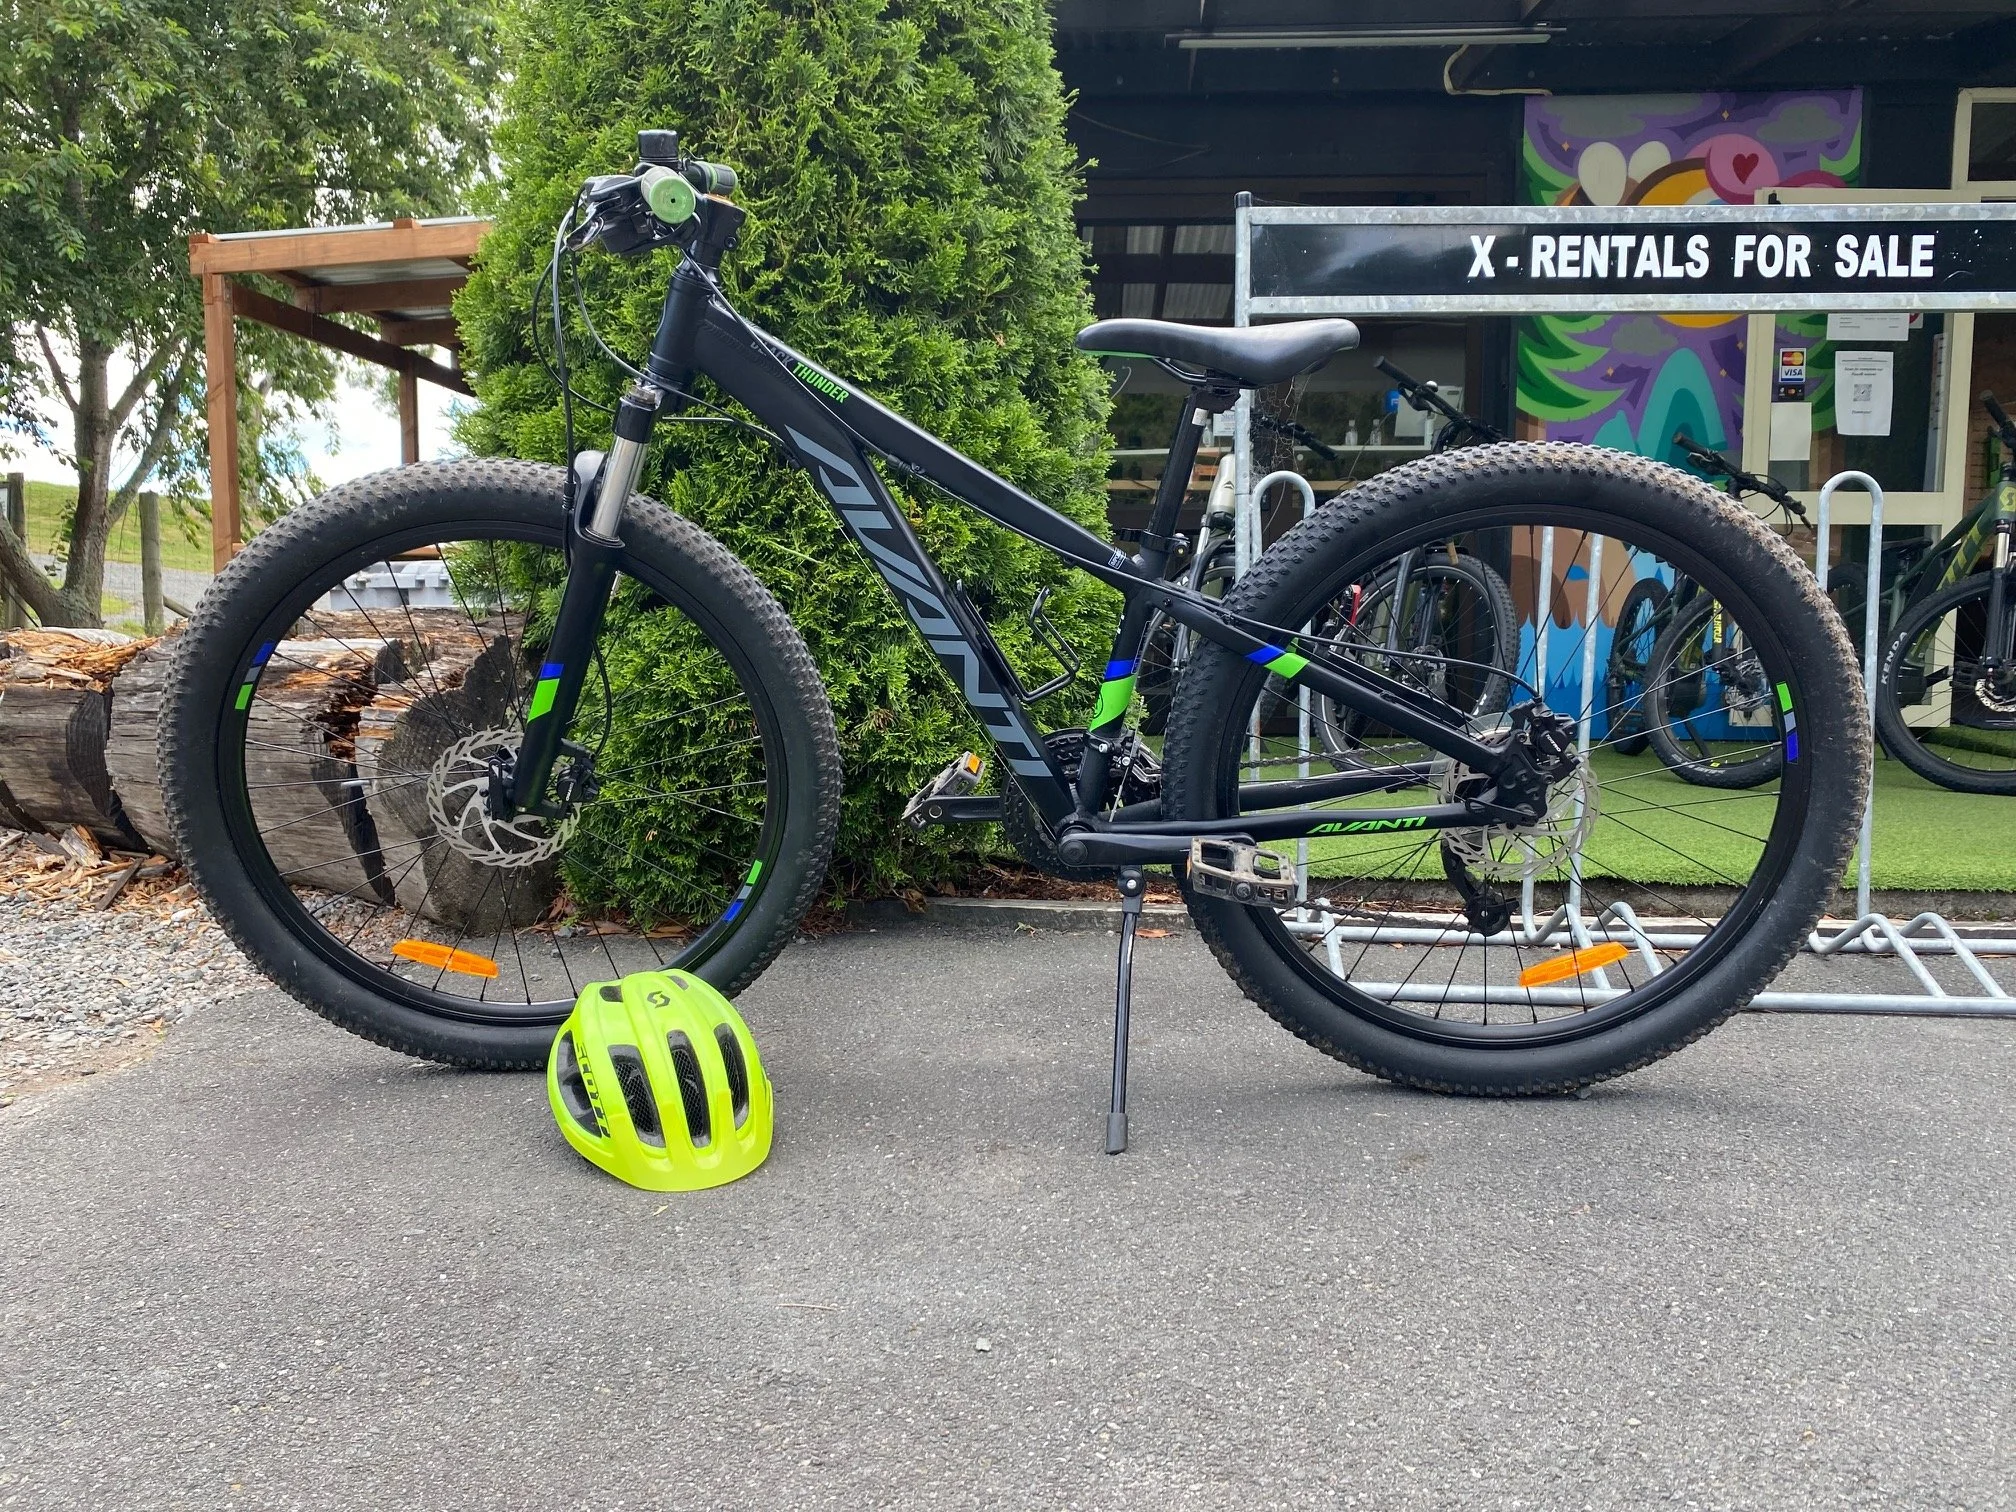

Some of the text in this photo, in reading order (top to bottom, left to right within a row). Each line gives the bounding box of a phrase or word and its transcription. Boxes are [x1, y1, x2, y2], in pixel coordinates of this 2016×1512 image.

[1530, 234, 1710, 278] RENTALS
[1733, 234, 1812, 278] FOR
[1834, 234, 1935, 278] SALE
[792, 361, 850, 404] THUNDER
[1783, 368, 1803, 377] VISA
[784, 424, 1053, 777] AVANTI
[1880, 631, 1908, 685] KENDA
[1306, 815, 1427, 835] AVANTI
